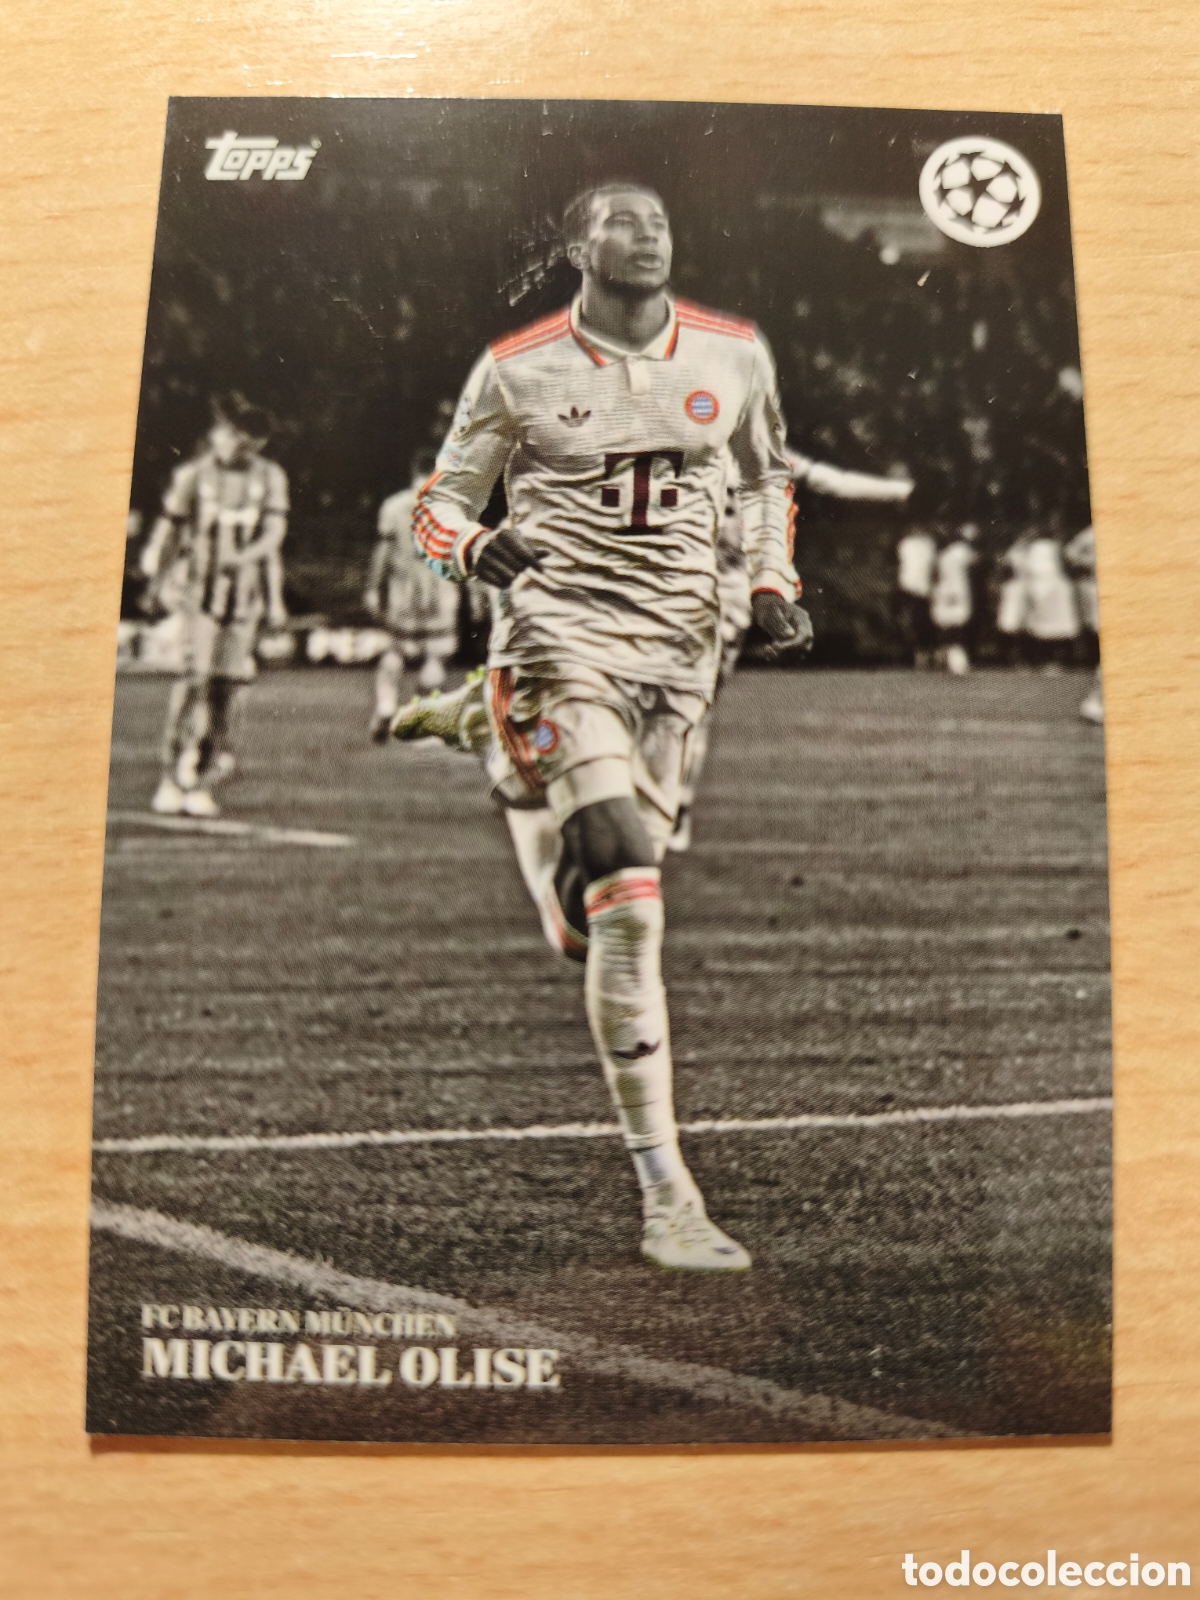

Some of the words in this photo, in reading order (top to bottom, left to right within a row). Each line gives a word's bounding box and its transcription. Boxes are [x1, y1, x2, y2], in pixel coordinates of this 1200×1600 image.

[603, 449, 685, 536] T
[141, 1303, 181, 1330] FC
[182, 1305, 301, 1334] BAYERN
[141, 1337, 393, 1387] MICHAEL
[399, 1346, 563, 1390] OLISE
